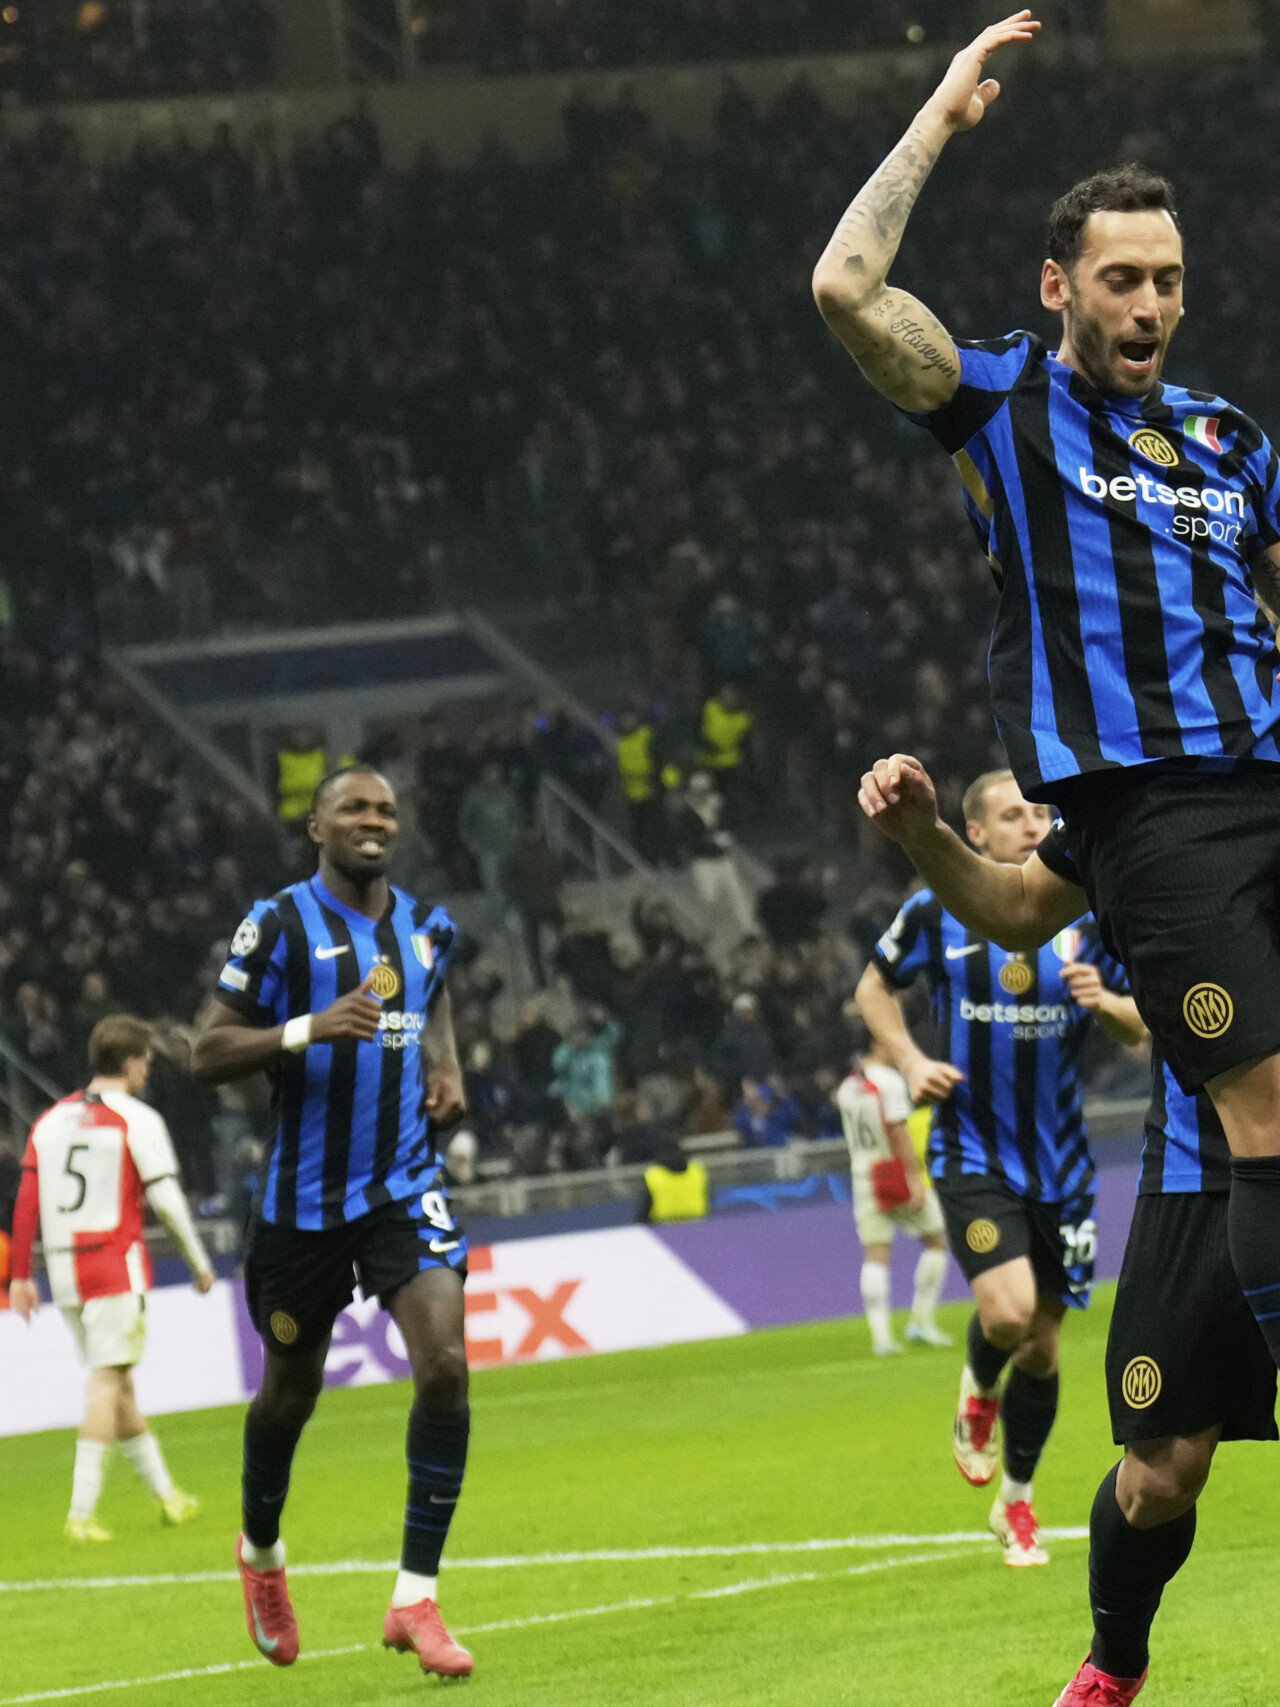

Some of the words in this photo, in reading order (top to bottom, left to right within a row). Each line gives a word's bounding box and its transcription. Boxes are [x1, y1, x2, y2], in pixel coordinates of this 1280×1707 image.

[1079, 466, 1245, 518] betsson
[960, 997, 1067, 1023] betsson
[57, 1144, 89, 1214] 5
[421, 1190, 454, 1232] 9
[1059, 1219, 1097, 1268] 16
